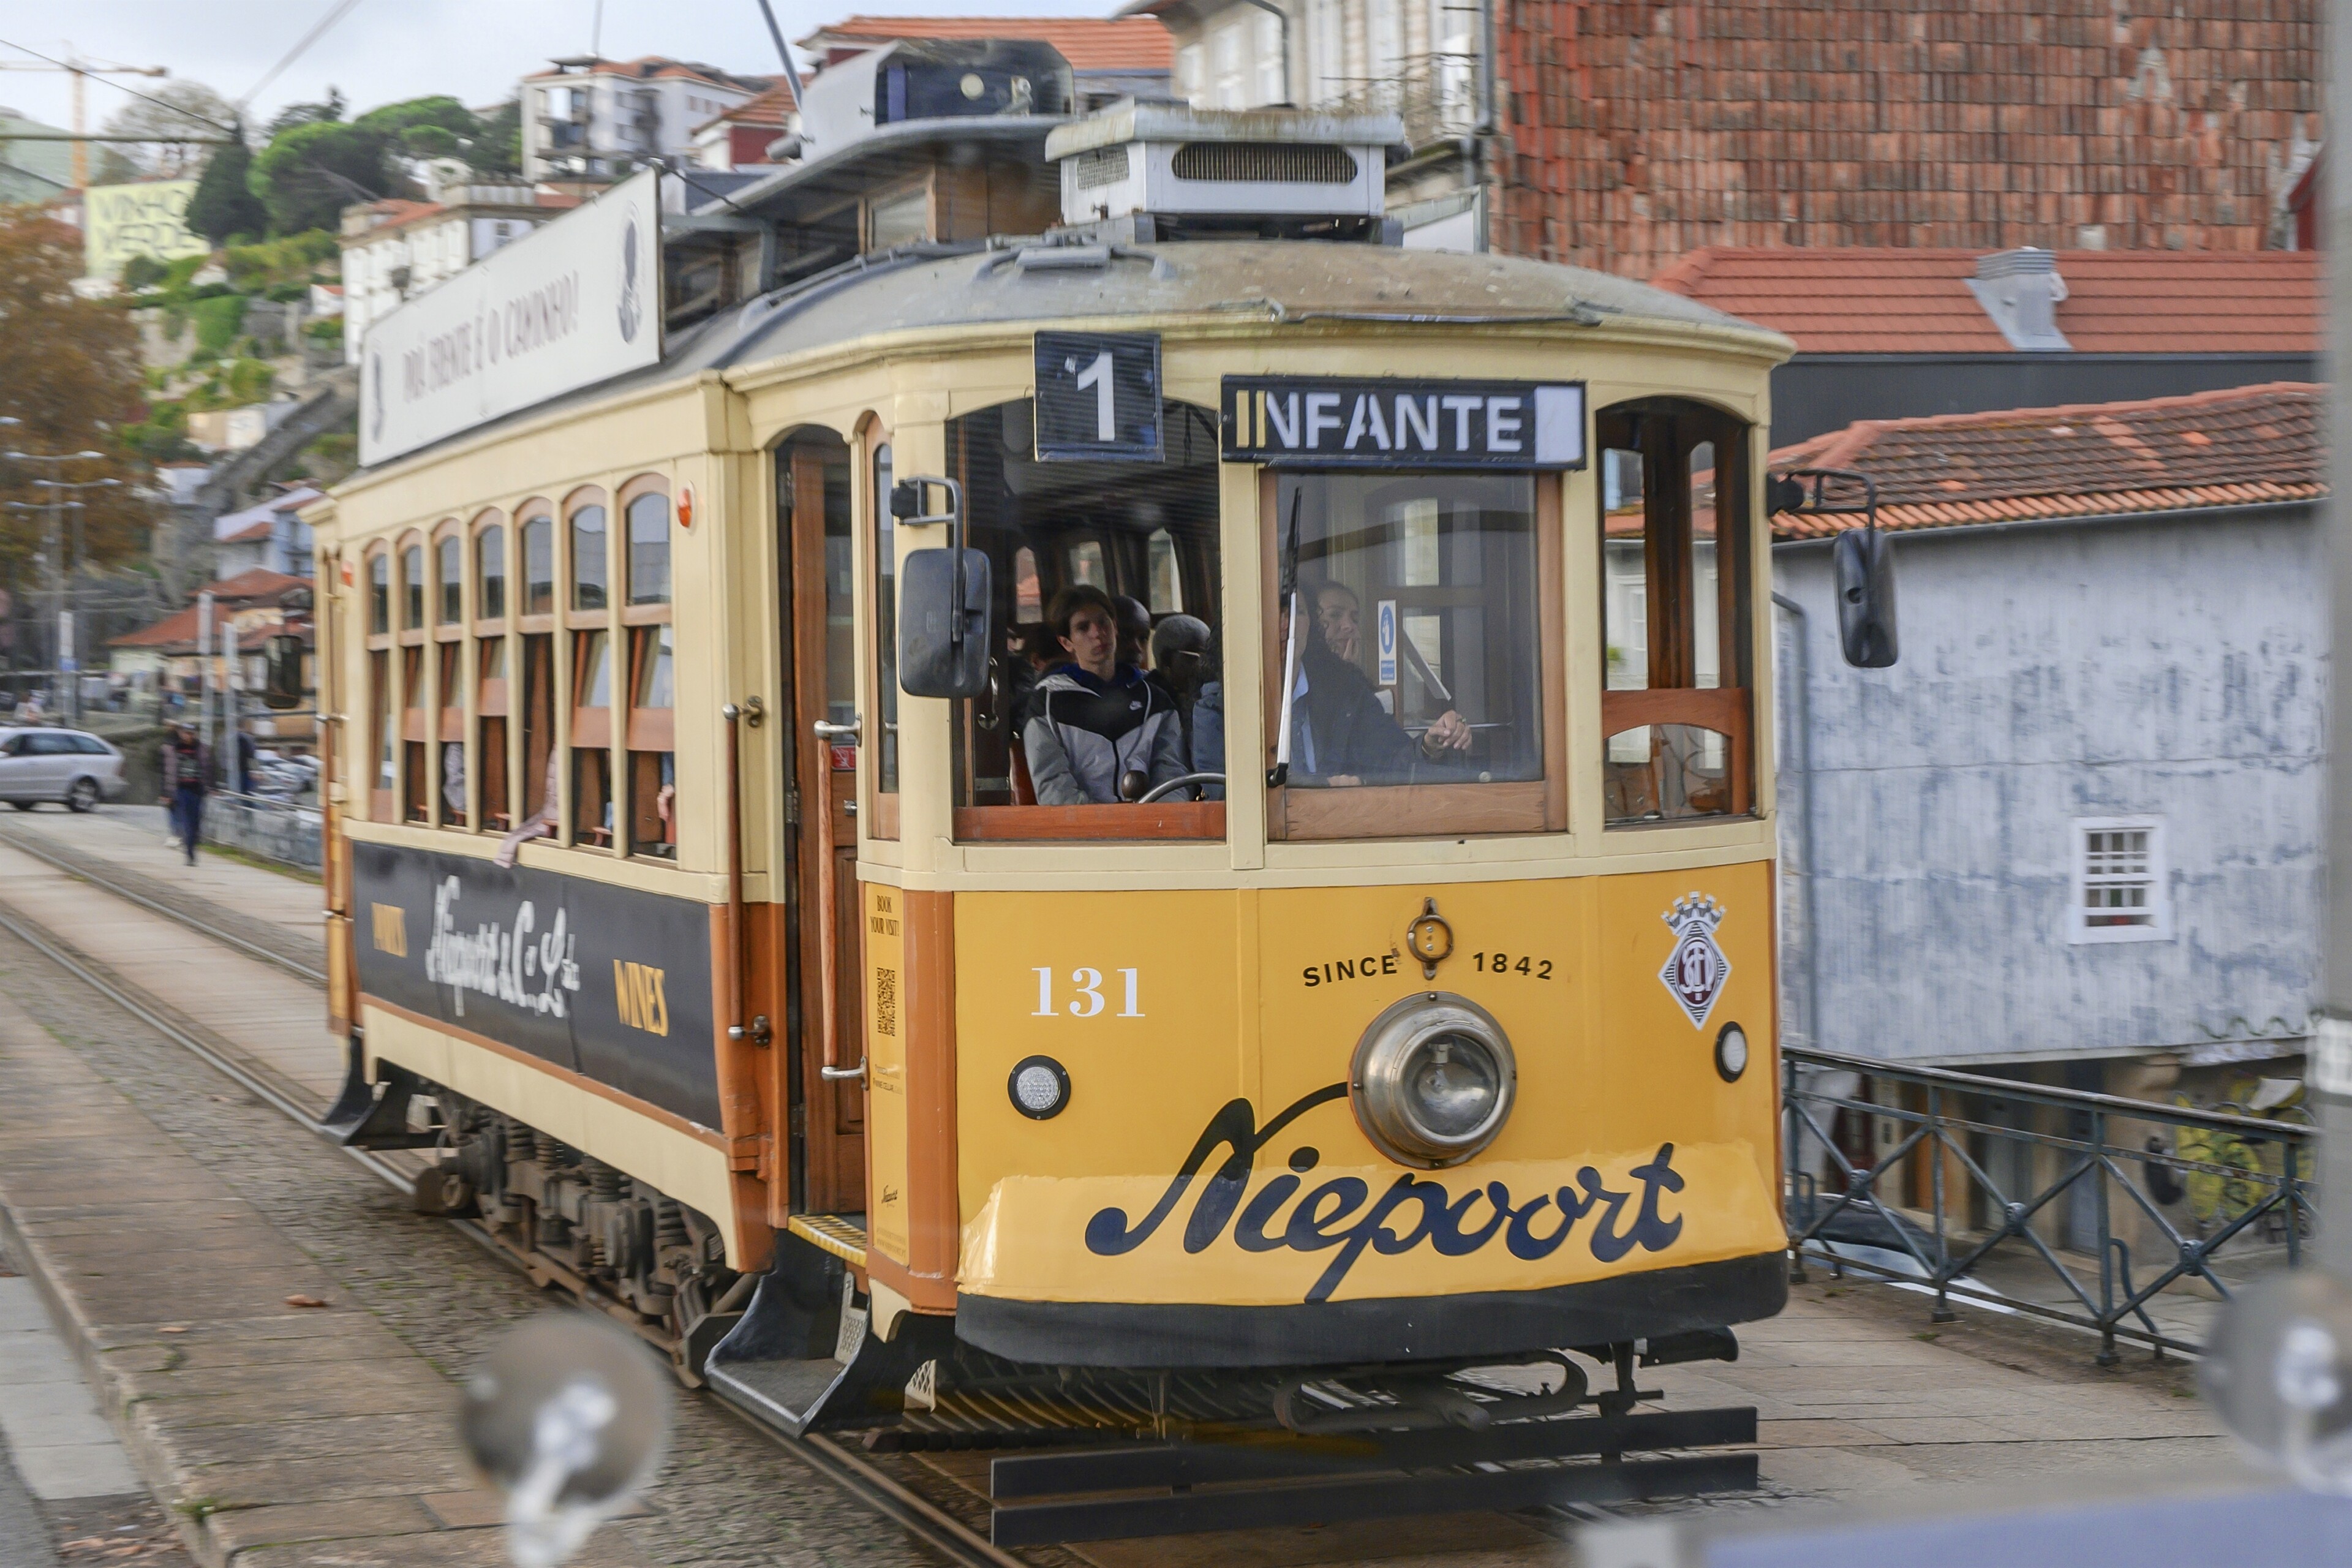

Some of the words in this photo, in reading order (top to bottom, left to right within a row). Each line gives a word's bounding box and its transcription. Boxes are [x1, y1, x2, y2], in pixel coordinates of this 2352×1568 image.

[1076, 352, 1117, 442] 1
[1236, 389, 1524, 453] INFANTE
[870, 916, 885, 935] YOUR
[885, 918, 900, 937] VISIT!
[876, 894, 892, 913] BOOK
[613, 959, 669, 1037] WINES
[1030, 966, 1147, 1019] 131
[1302, 953, 1400, 988] SINCE
[1472, 950, 1554, 981] 1842
[1085, 1081, 1685, 1305] Niepoort
